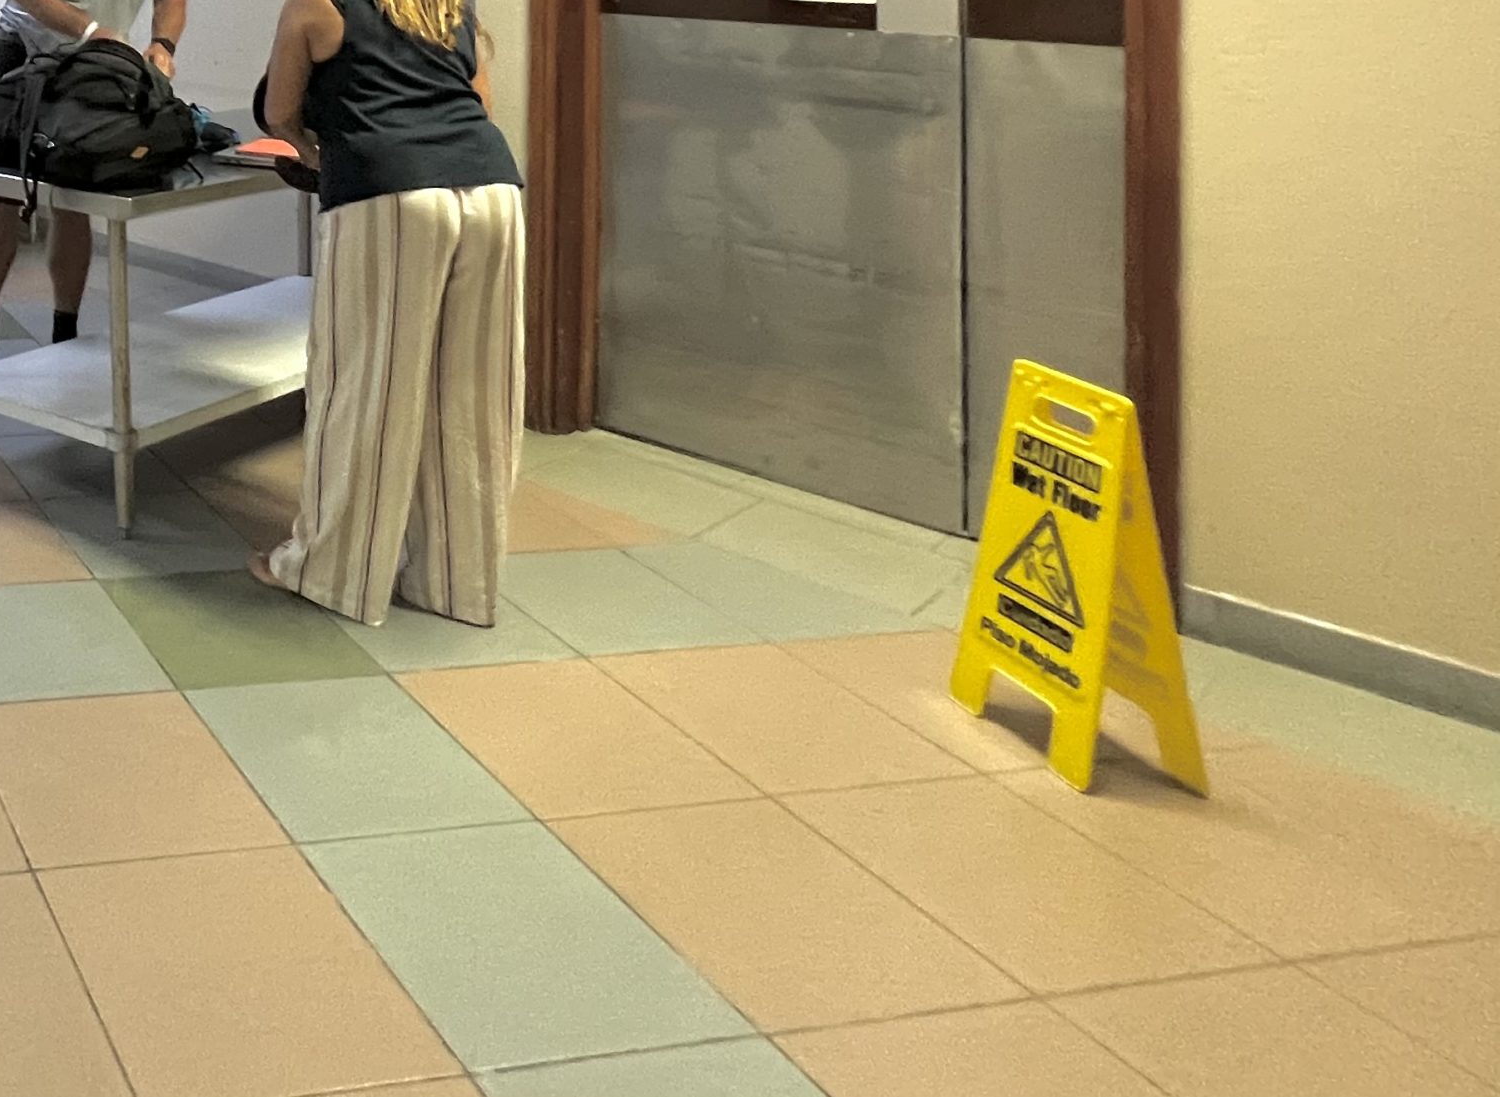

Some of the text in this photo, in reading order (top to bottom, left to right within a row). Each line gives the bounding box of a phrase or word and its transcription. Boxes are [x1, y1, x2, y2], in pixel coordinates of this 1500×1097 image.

[1012, 461, 1102, 522] Wet Floor
[1014, 432, 1102, 492] CAUTION
